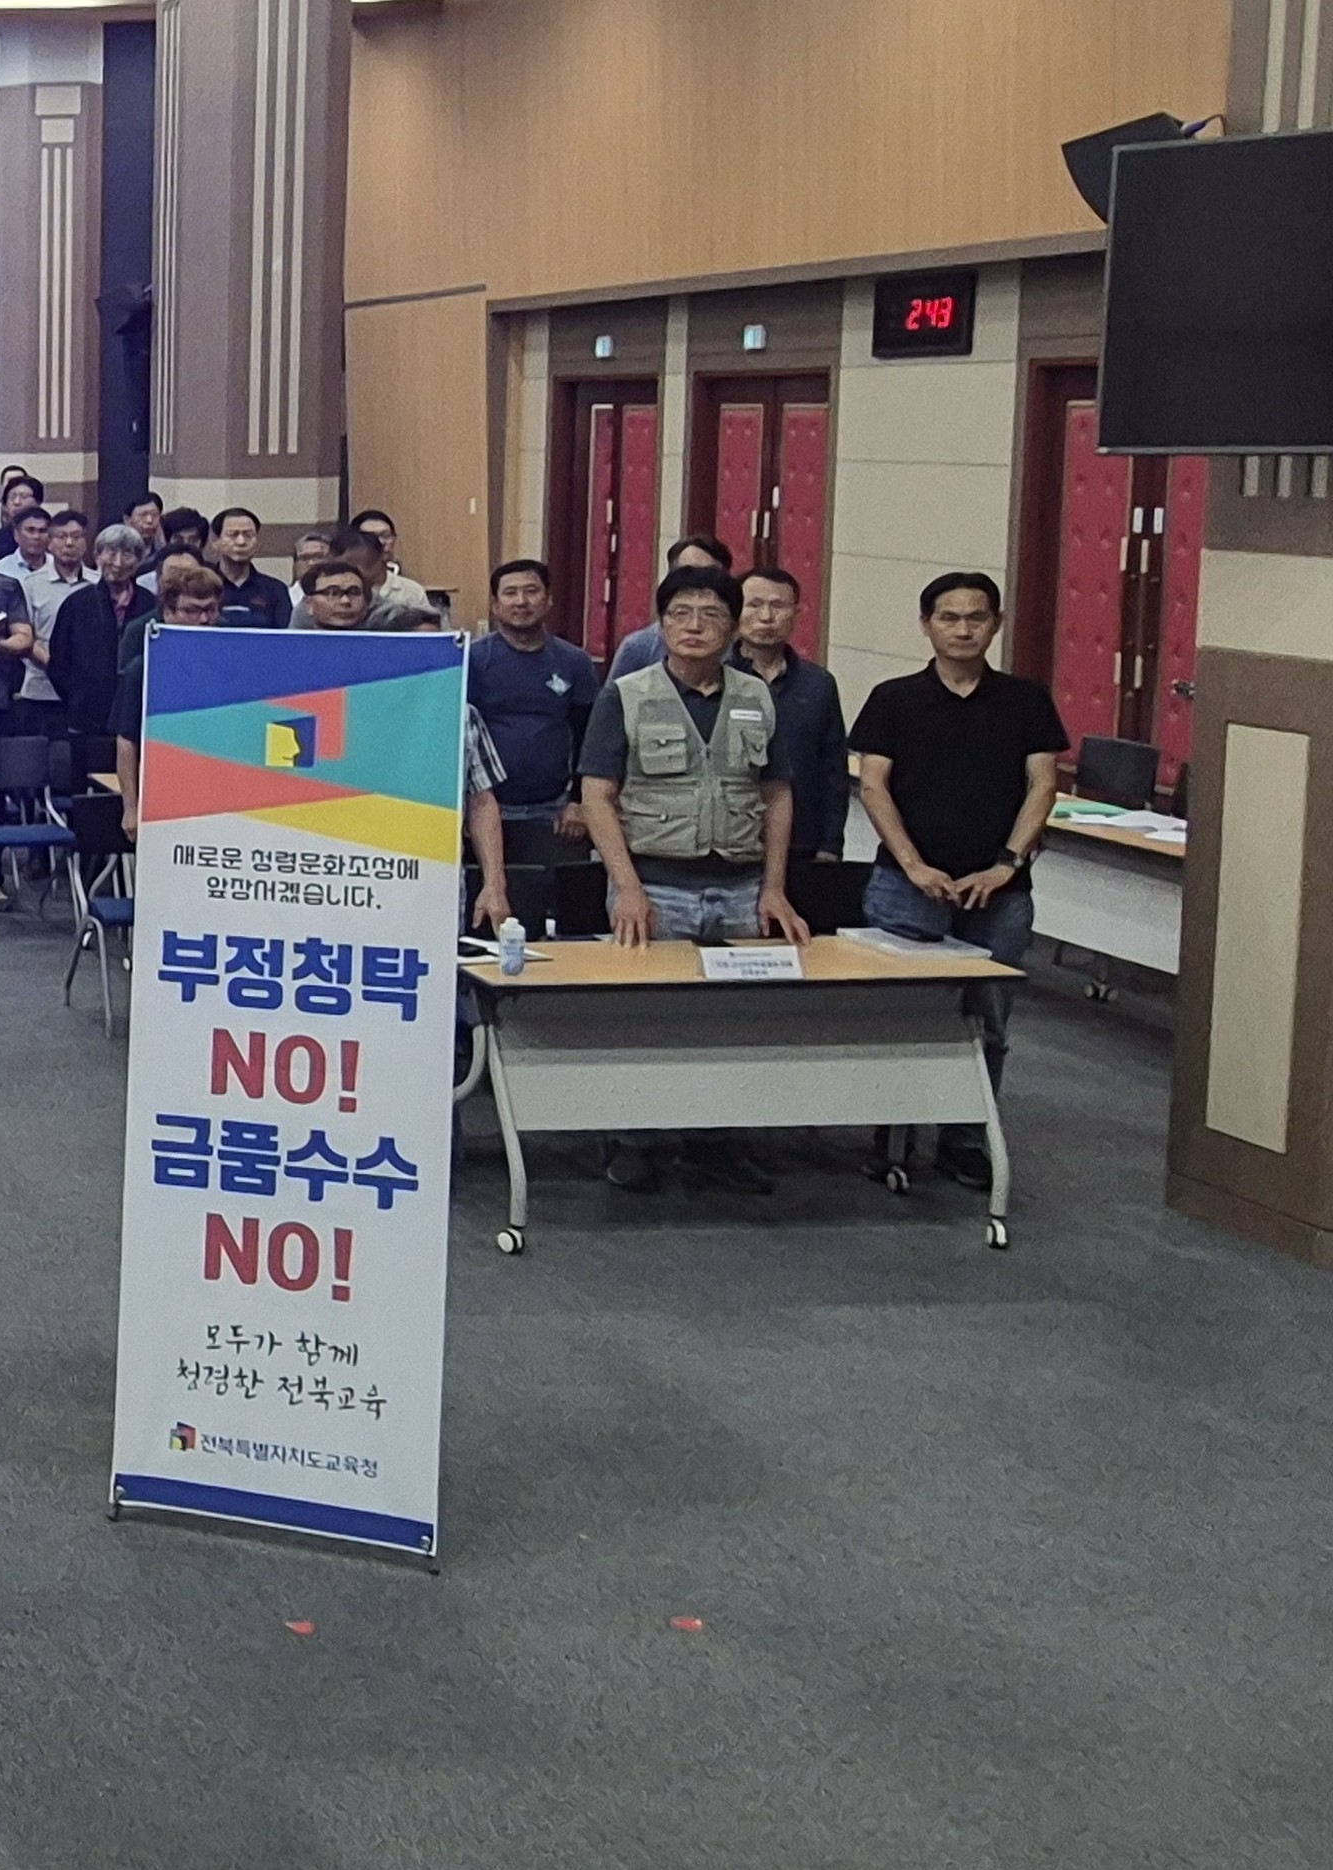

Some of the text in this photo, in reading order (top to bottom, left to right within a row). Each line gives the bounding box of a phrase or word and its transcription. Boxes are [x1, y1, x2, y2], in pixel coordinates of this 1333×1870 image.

[173, 843, 420, 881] 새로운 청렴문화조성에
[206, 876, 383, 909] 앞장서겠습니다.
[157, 929, 430, 1022] 부정청탁
[210, 1027, 361, 1114] NO!
[150, 1113, 420, 1211] 금품수수
[203, 1211, 354, 1303] NO!
[206, 1324, 359, 1368] 모두가 함께
[176, 1357, 388, 1421] 청렴한 전북교육
[200, 1432, 379, 1479] 전북특별자치도교육청
